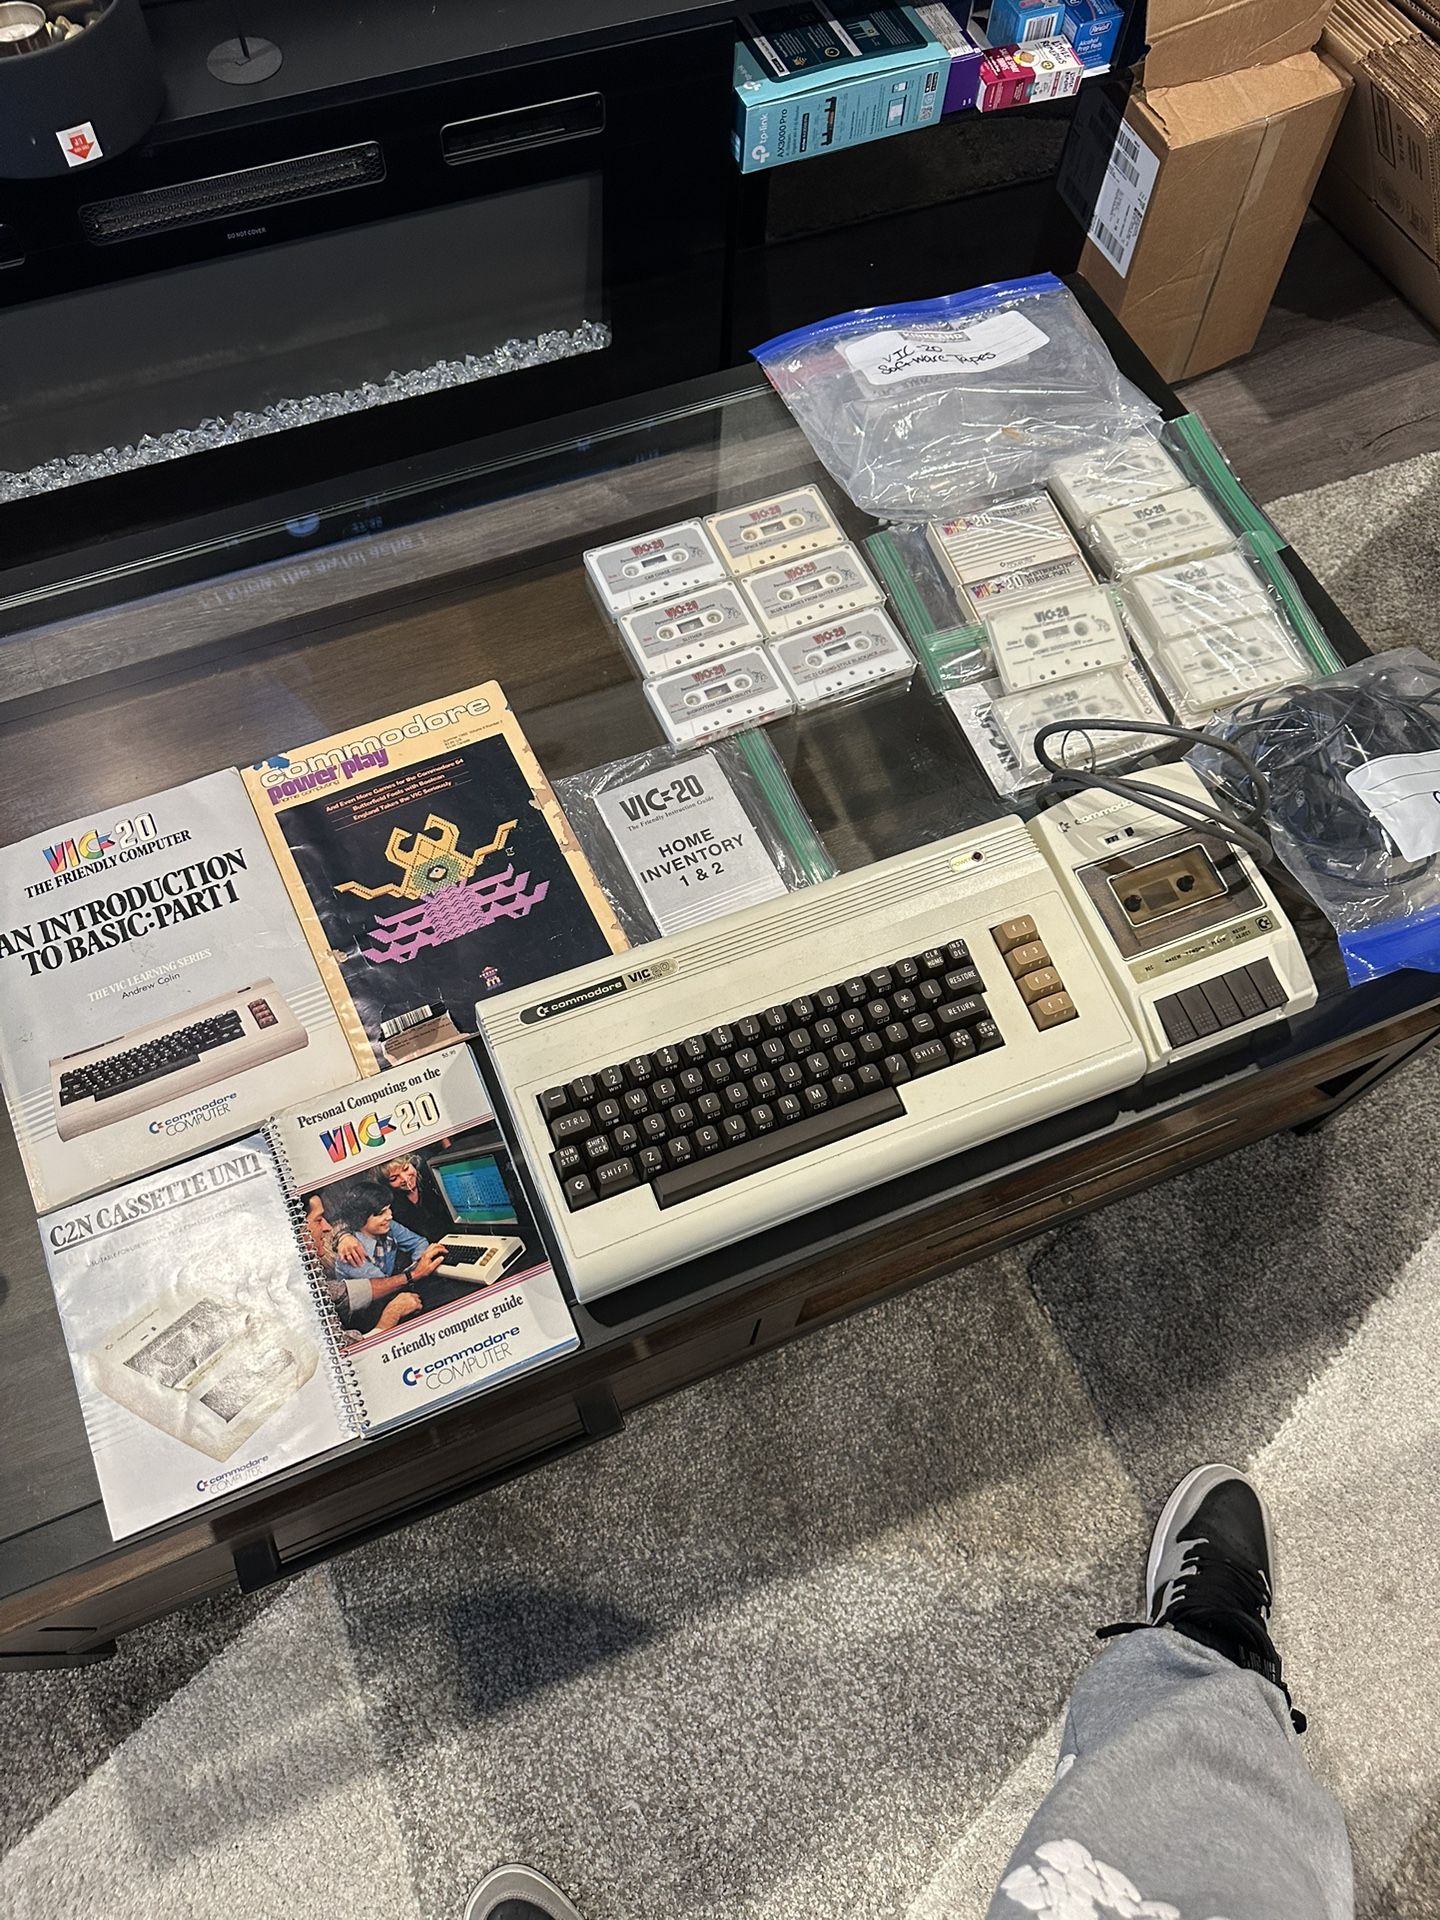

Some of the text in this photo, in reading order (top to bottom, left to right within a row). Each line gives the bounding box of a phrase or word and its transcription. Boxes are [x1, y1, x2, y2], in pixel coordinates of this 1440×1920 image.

[1077, 44, 1090, 53] Prep
[1080, 37, 1099, 46] Alcohol
[777, 108, 788, 158] AX3000 Pro
[260, 696, 491, 789] commodore
[325, 757, 464, 812] And Even More Games for the Commodore 64
[351, 773, 445, 811] Butterfield Fools with Boolean
[352, 780, 452, 821] England Takes the VIC Seriously
[627, 795, 714, 831] The Friendly Instruction Guide
[1074, 799, 1135, 825] commodo
[658, 828, 715, 858] HOME
[24, 829, 192, 899] THE FRIENDLY COMPUTER
[640, 834, 744, 884] INVENTORY
[679, 861, 725, 887] 1 & 2
[0, 848, 248, 959] AN INTRODUCTION
[21, 944, 63, 976] TO
[925, 949, 939, 959] CLR
[953, 949, 966, 957] DEL
[927, 957, 944, 968] HOME
[88, 948, 212, 1002] THE VIC LEARNING SERIES
[948, 970, 977, 985] RESTORE
[121, 972, 181, 1000] Andrew Colin
[550, 980, 622, 1011] commodore
[628, 967, 651, 984] VIC
[947, 1001, 976, 1016] RETURN
[849, 1014, 856, 1023] P
[770, 1043, 777, 1053] U
[915, 1044, 942, 1059] SHIFT
[742, 1053, 750, 1063] Y
[715, 1063, 722, 1073] T
[688, 1073, 695, 1084] R
[760, 1078, 768, 1088] H
[297, 1066, 441, 1129] Personal Computing on the
[661, 1084, 668, 1095] E
[733, 1087, 741, 1098] G
[630, 1094, 641, 1105] W
[705, 1098, 712, 1108] F
[164, 1092, 238, 1125] commodore
[604, 1104, 612, 1115] Q
[678, 1108, 686, 1118] D
[165, 1103, 231, 1137] COMPUTER
[559, 1115, 585, 1131] CTRL
[650, 1119, 658, 1129] S
[622, 1129, 631, 1139] A
[587, 1137, 605, 1149] SHIFT
[590, 1143, 608, 1155] LOCK
[560, 1148, 574, 1157] RUN
[561, 1154, 578, 1166] STOP
[600, 1163, 630, 1179] SHIFT
[49, 1154, 262, 1248] C2N CASSETTE UNIT
[381, 1294, 524, 1364] a friendly computer guide
[424, 1325, 521, 1372] commodore
[425, 1342, 512, 1391] COMPUTER
[209, 1454, 269, 1484] commodore
[209, 1464, 264, 1495] COMPUTER
